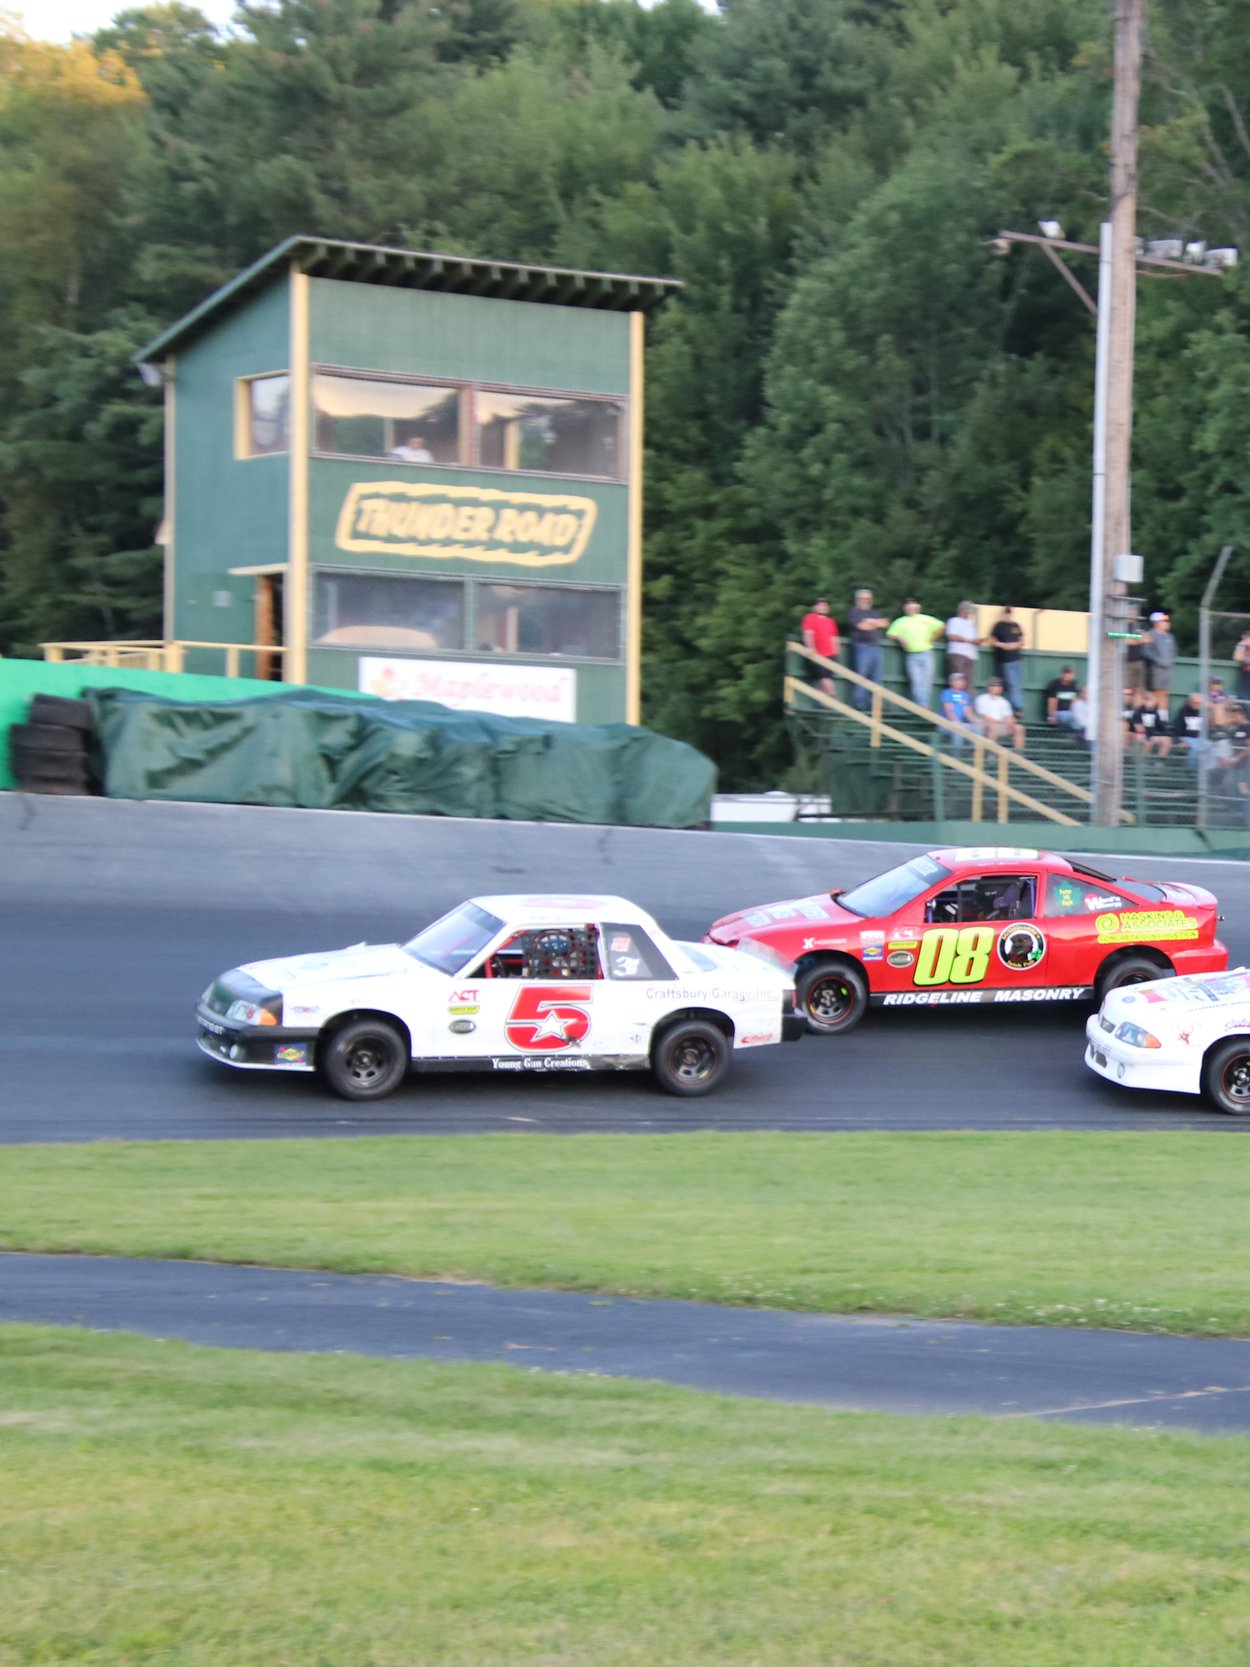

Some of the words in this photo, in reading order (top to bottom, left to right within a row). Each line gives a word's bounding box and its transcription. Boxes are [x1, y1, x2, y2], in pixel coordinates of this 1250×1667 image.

[356, 498, 495, 541] THUNDER
[494, 508, 580, 546] ROAD
[1123, 918, 1196, 930] ASSOCIATES
[913, 926, 996, 987] 08
[449, 990, 480, 1002] ACT
[646, 988, 707, 1001] Craftsbury
[883, 992, 983, 1005] RIDGELINE
[994, 988, 1084, 1001] MASONRY
[504, 983, 594, 1053] 5
[492, 1058, 521, 1071] Young
[544, 1057, 590, 1070] Creations
